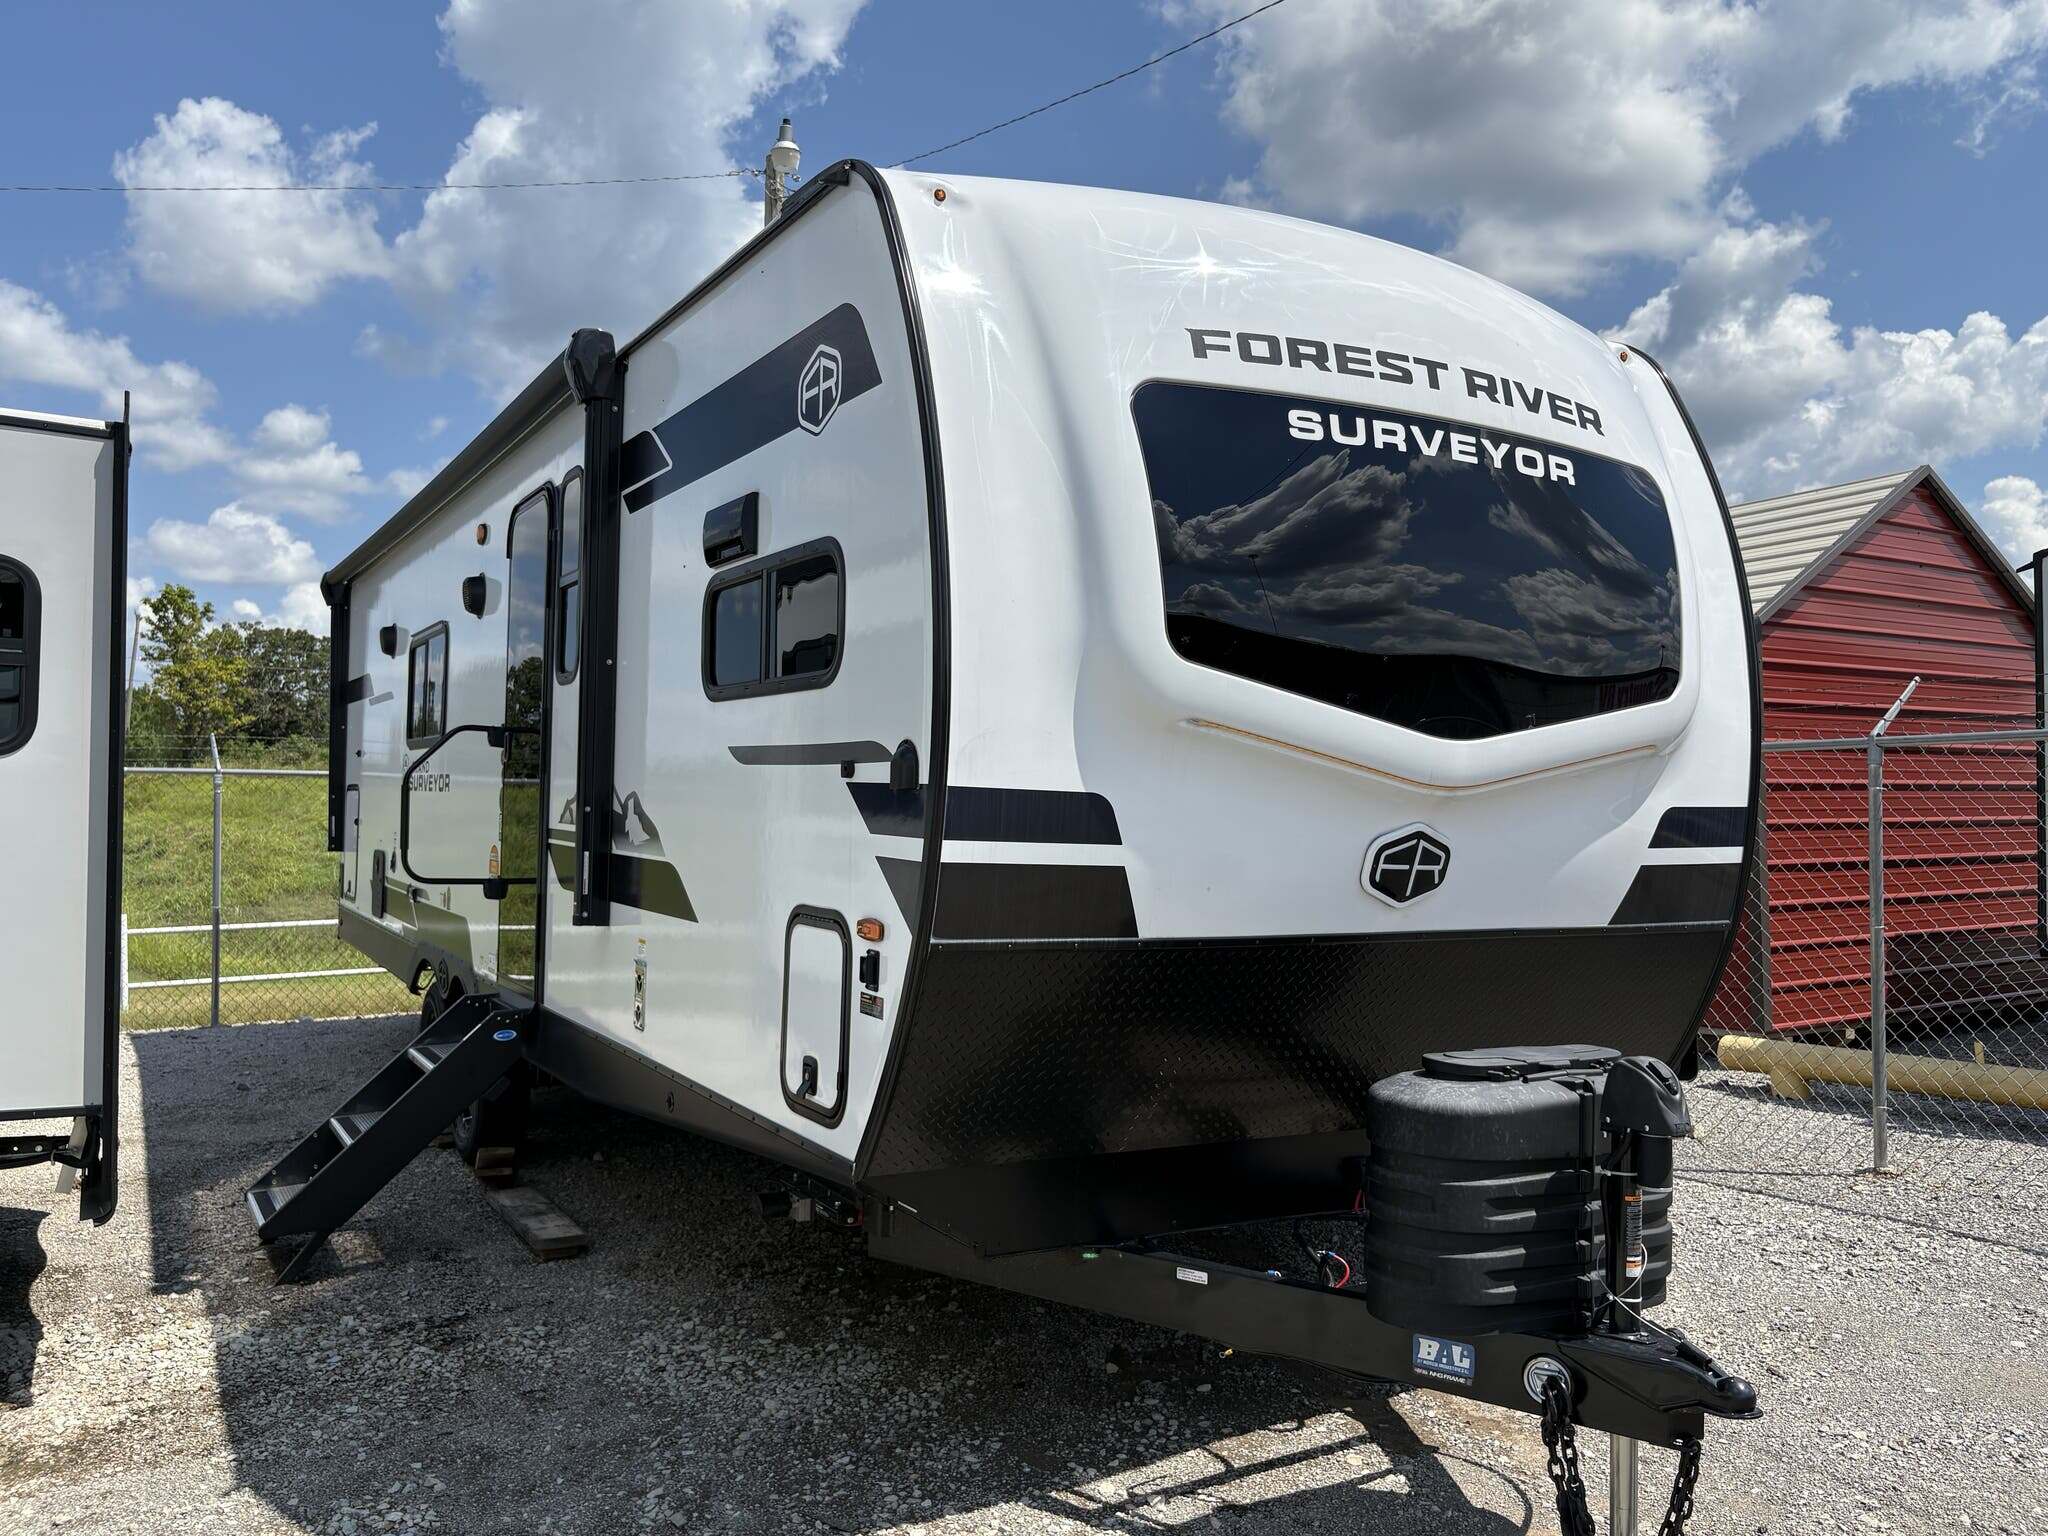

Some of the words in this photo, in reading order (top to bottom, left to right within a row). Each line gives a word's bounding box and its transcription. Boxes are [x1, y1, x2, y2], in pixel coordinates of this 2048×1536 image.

[1185, 328, 1448, 390] FOREST
[1461, 367, 1605, 436] RIVER
[1288, 409, 1576, 485] SURVEYOR
[409, 774, 450, 792] SURVEYOR
